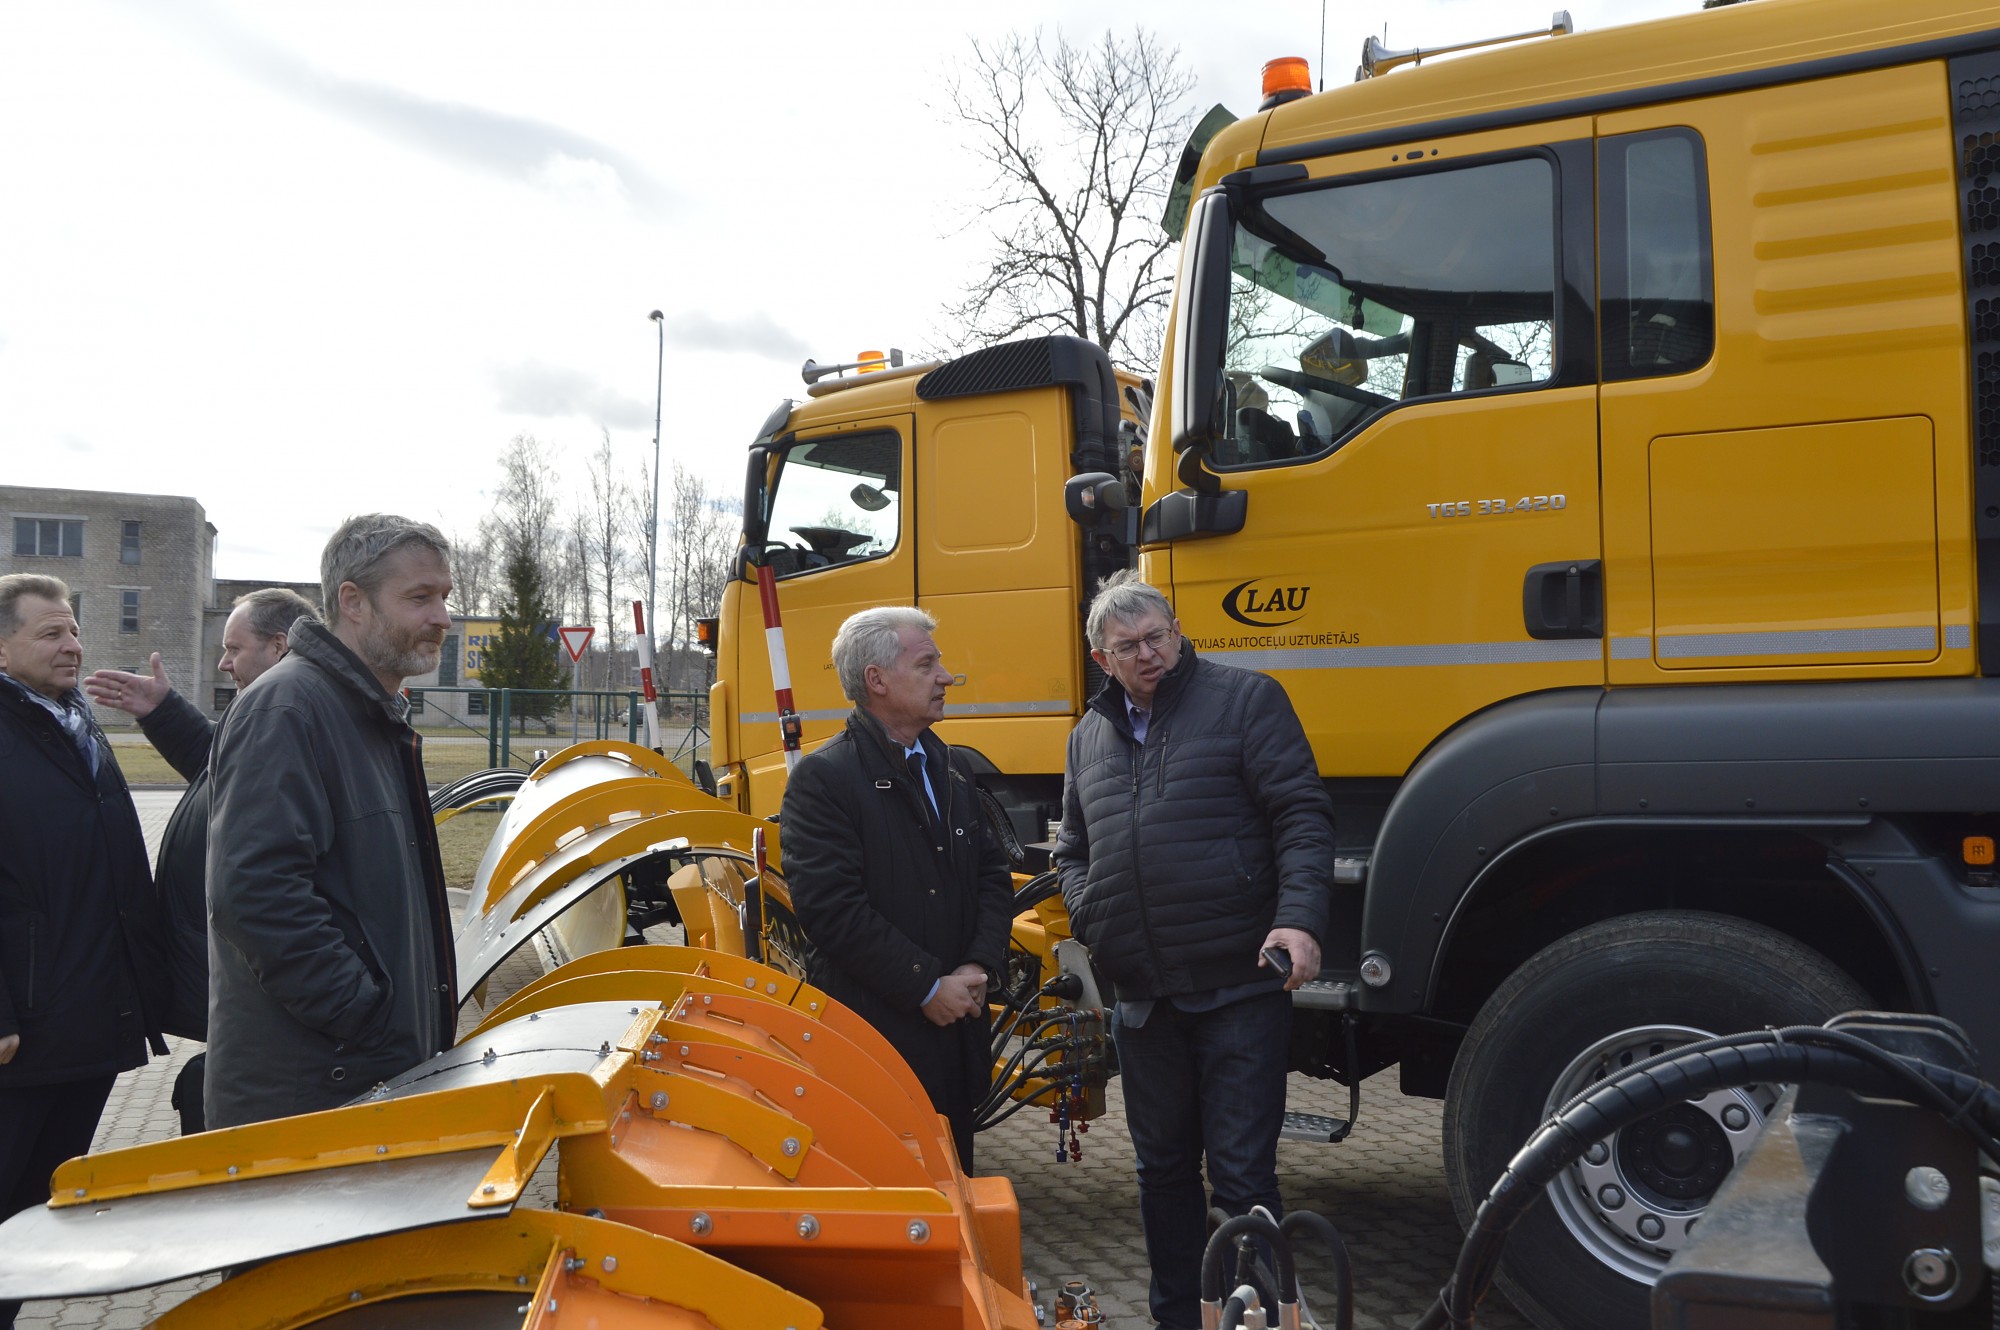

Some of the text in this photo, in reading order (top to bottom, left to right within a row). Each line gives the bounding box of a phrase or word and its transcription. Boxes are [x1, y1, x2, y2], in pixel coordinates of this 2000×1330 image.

[1426, 494, 1567, 518] TGS 33.420
[1244, 586, 1311, 613] LAU
[1190, 631, 1360, 650] TVIJAS AUTOCEĻU UZTURĒTĀJS
